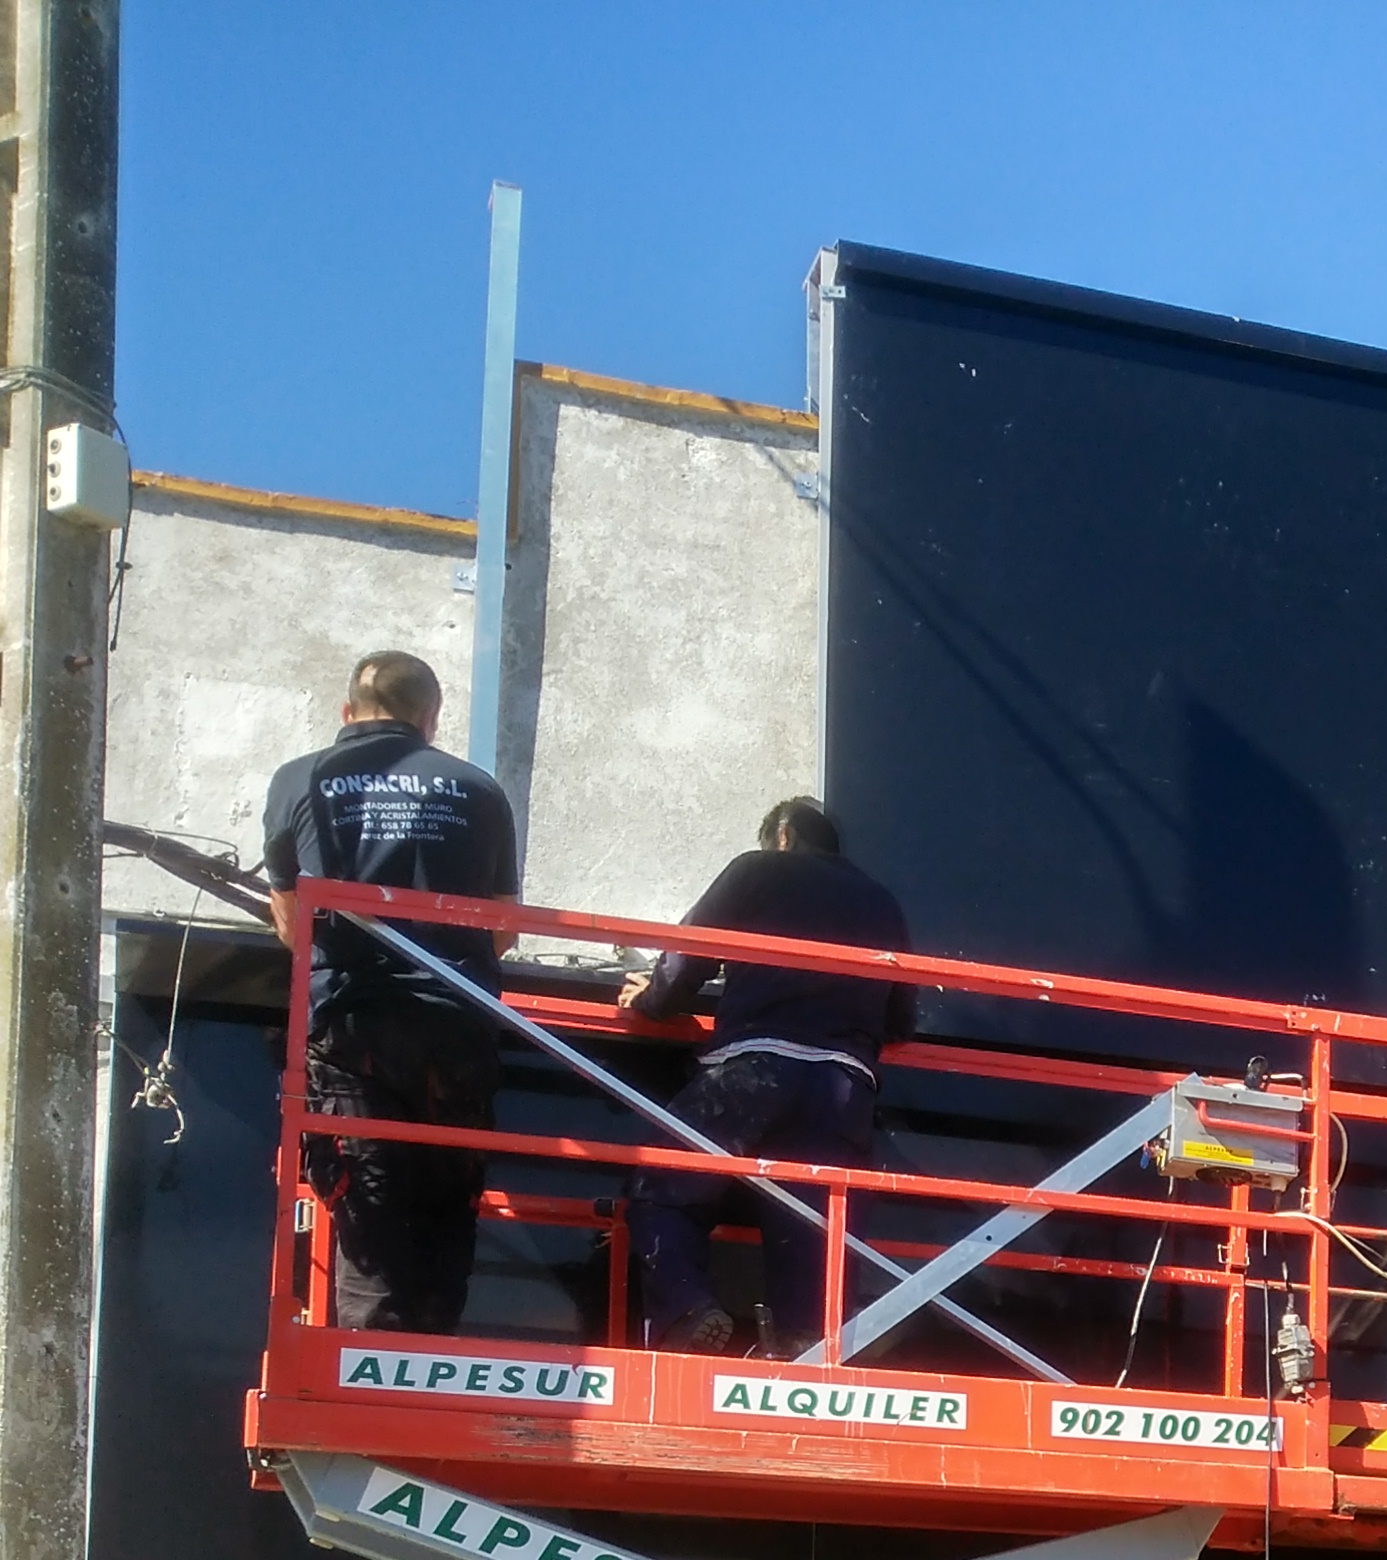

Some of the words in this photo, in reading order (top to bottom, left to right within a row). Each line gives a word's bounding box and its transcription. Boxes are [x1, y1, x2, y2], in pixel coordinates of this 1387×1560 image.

[319, 774, 428, 798] CONSACRI,
[433, 776, 468, 799] S.L.
[332, 812, 371, 826] CORTINA
[372, 811, 379, 819] Y
[380, 811, 468, 826] ACRISTALAMIENTOS
[344, 802, 407, 812] MONTADORES
[409, 802, 422, 810] DE
[424, 803, 453, 813] MURO
[383, 831, 395, 840] de
[397, 831, 405, 839] la
[407, 831, 445, 841] Frontera
[346, 1356, 608, 1399] ALPESUR
[721, 1383, 961, 1425] ALQUILER
[1059, 1407, 1125, 1437] 902
[1141, 1413, 1201, 1441] 100
[1212, 1418, 1277, 1446] 204
